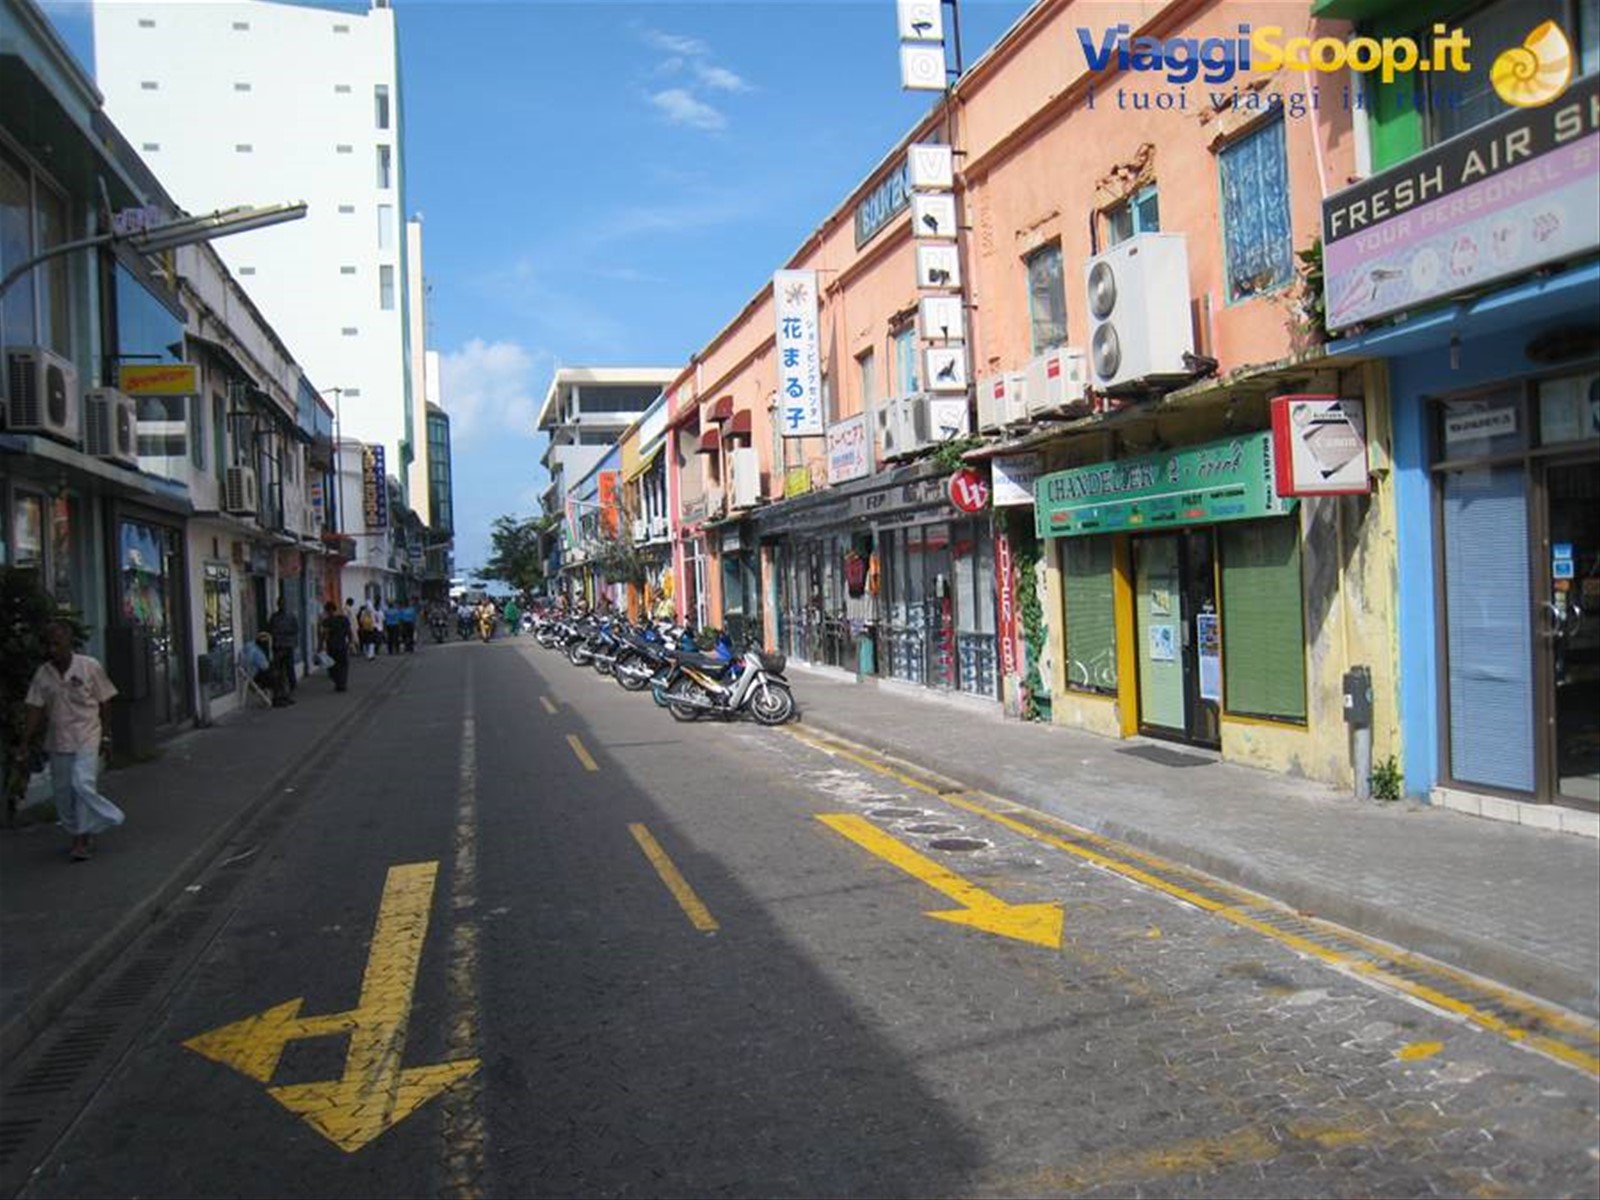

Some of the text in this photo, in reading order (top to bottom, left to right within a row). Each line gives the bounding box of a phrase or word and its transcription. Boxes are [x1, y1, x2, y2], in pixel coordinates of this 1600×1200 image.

[1331, 166, 1443, 238] FRESH
[1461, 126, 1532, 183] AIR
[1355, 219, 1411, 254] YOUR
[1422, 163, 1559, 225] PERSONAL
[782, 316, 806, 429] 花まる子
